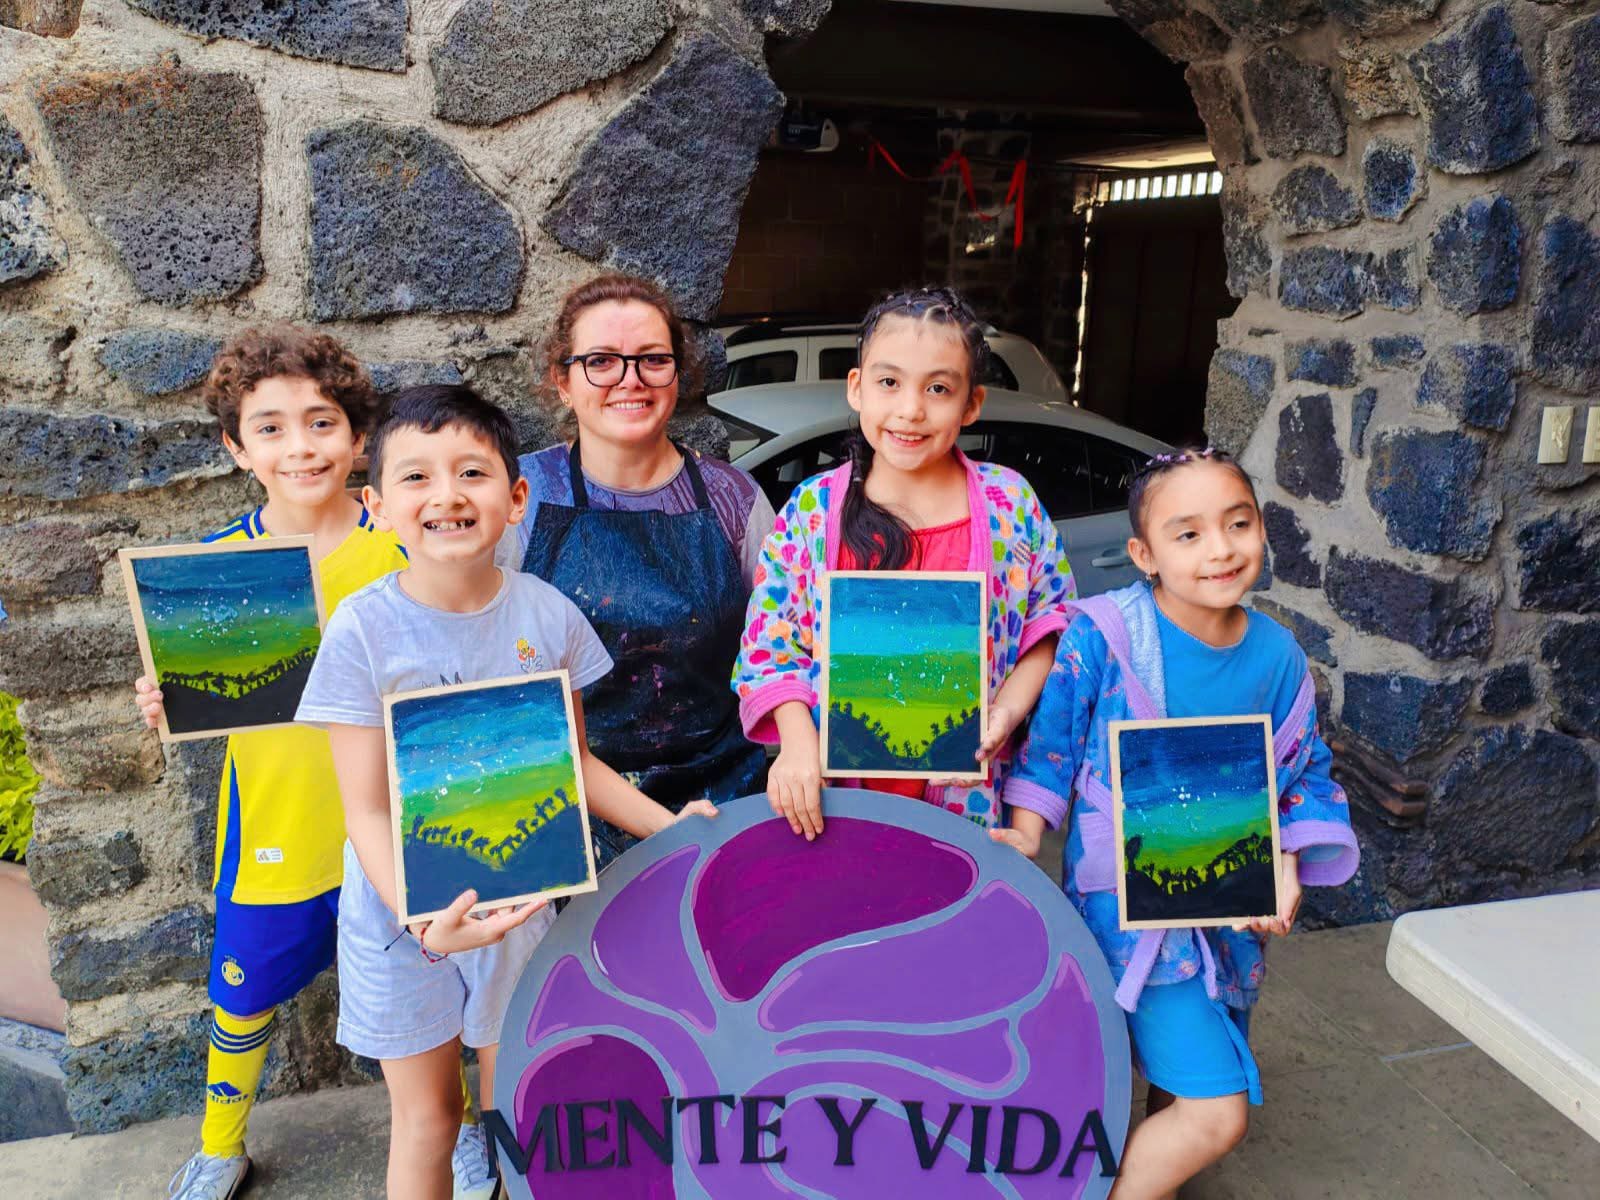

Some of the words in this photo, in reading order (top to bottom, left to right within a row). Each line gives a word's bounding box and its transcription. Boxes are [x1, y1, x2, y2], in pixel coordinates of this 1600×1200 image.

[482, 1095, 788, 1179] MENTE
[813, 1096, 878, 1166] Y
[901, 1100, 1119, 1178] VIDA
